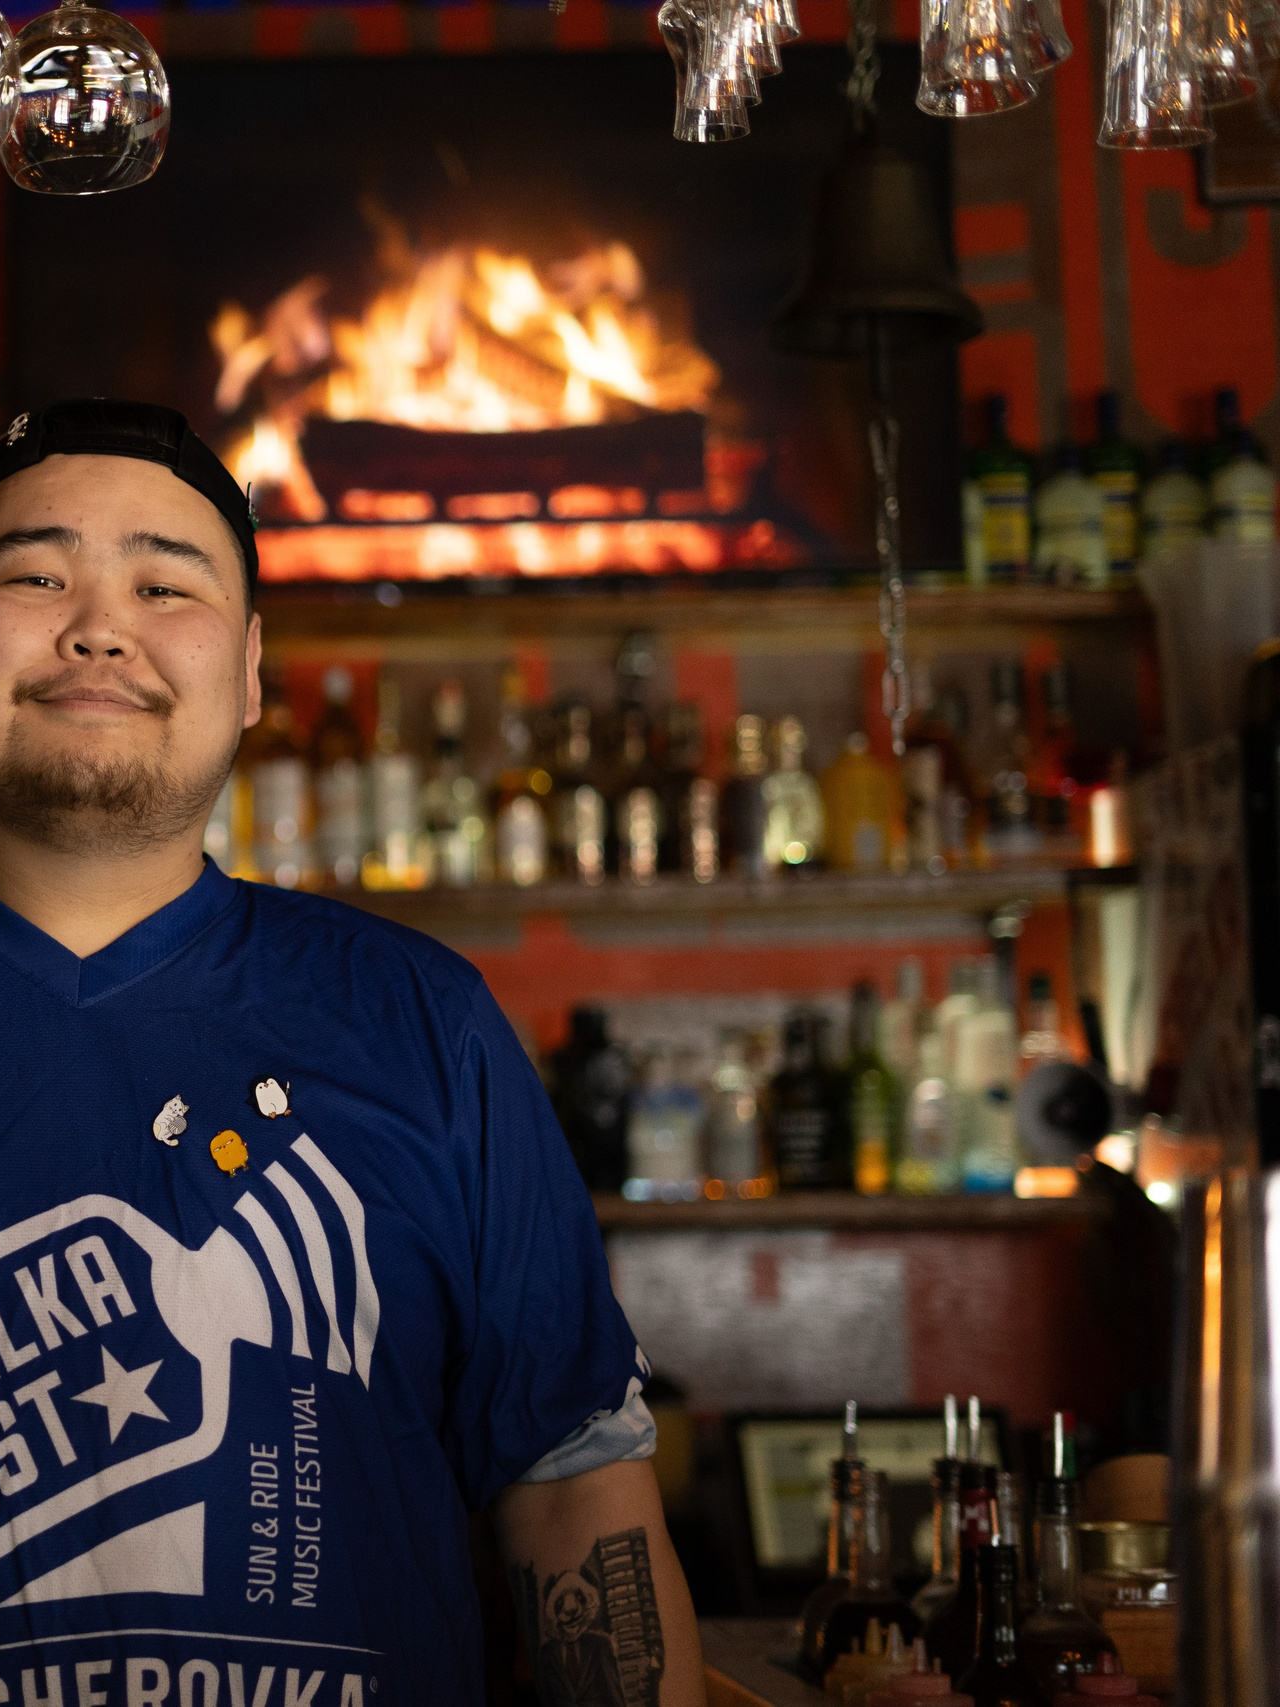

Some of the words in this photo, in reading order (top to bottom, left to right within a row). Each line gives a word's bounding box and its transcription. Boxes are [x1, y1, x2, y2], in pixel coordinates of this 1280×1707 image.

[250, 1442, 279, 1509] RIDE
[290, 1382, 321, 1508] FESTIVAL
[251, 1517, 279, 1538] &
[246, 1544, 278, 1605] SUN
[291, 1515, 321, 1608] MUSIC
